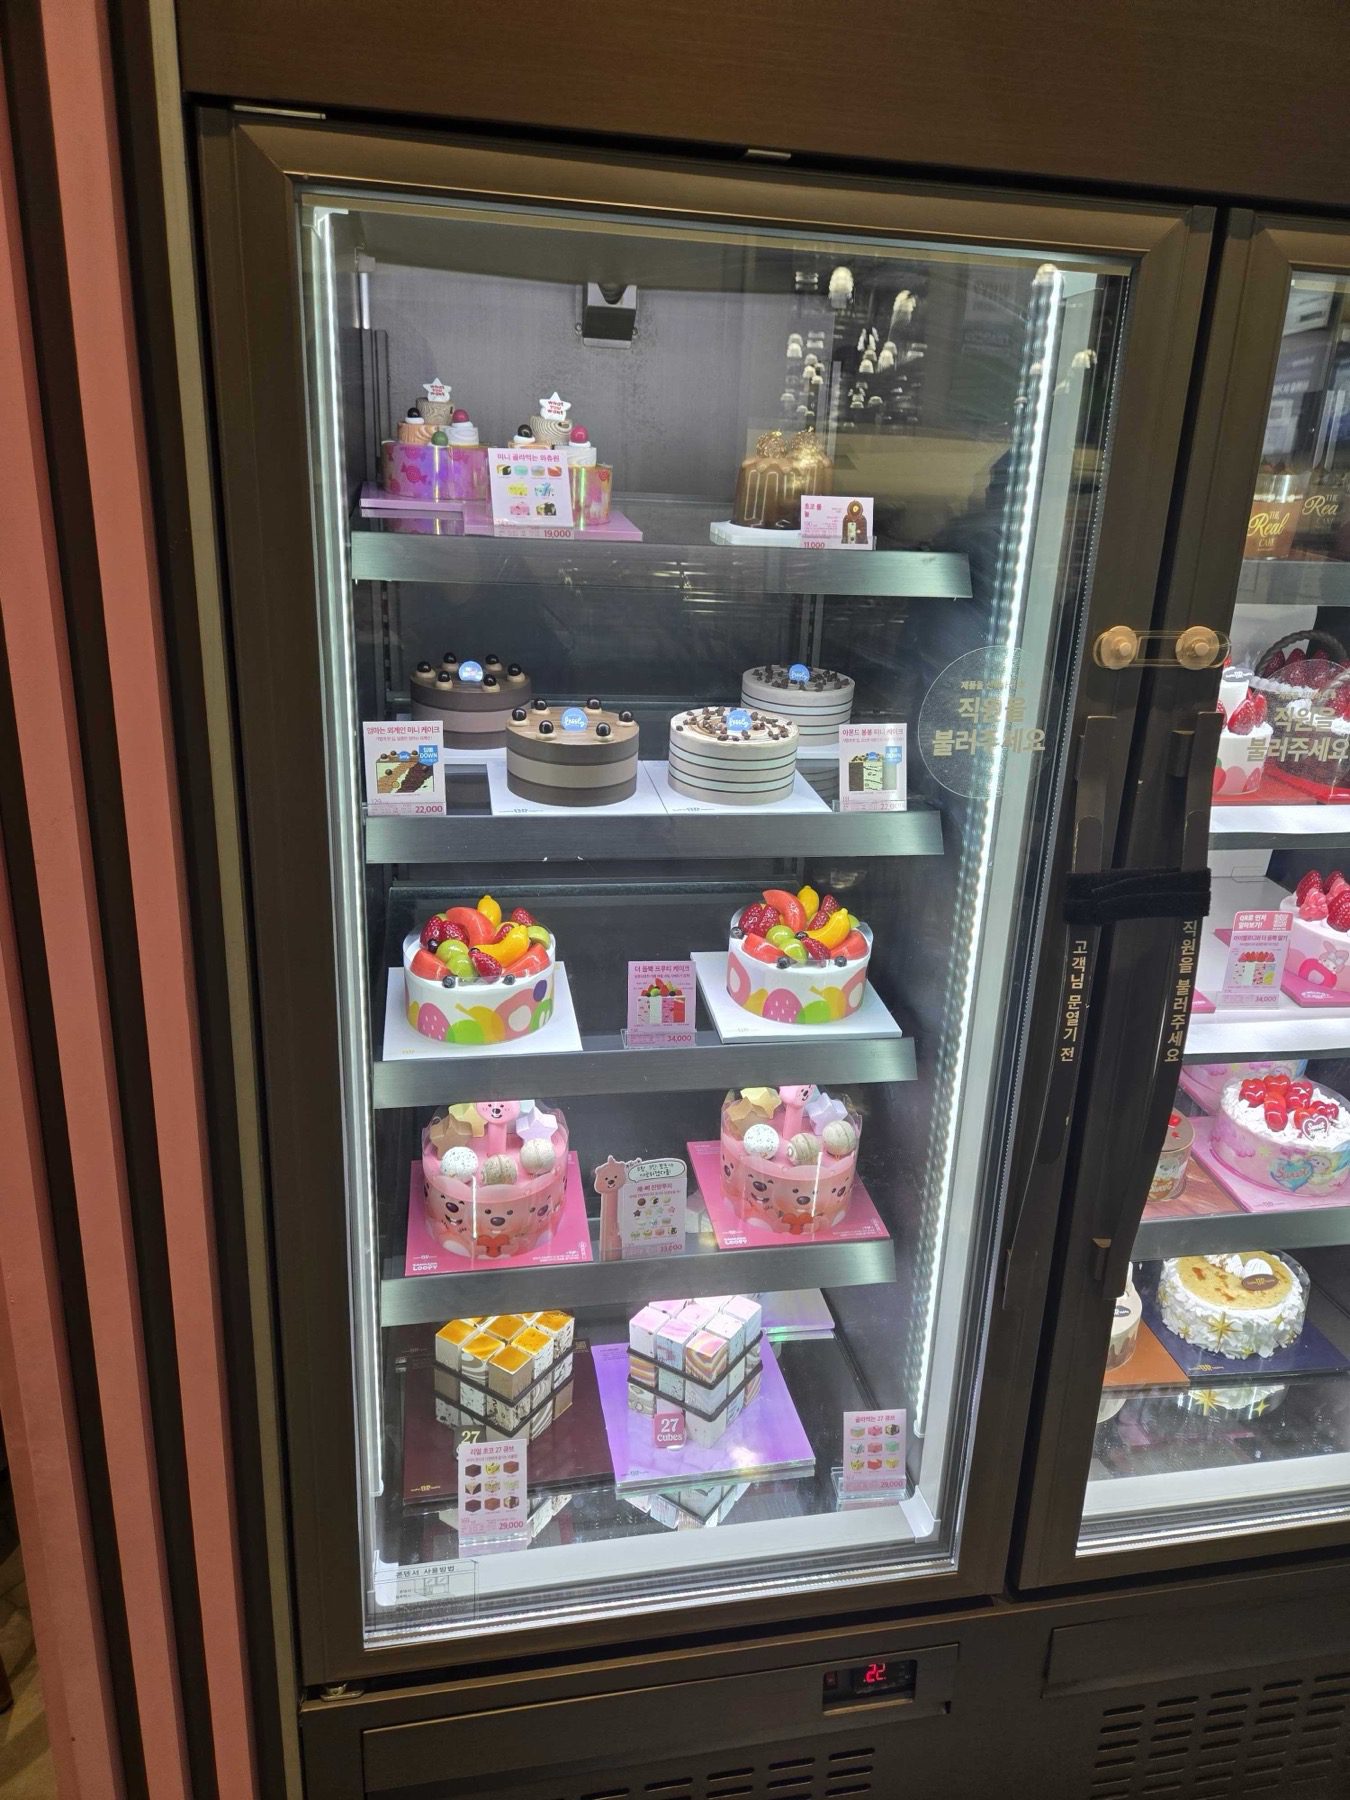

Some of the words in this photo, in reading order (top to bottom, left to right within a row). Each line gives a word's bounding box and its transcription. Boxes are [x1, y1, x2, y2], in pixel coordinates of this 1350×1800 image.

[544, 530, 571, 538] 19,000
[1247, 512, 1290, 538] Real
[958, 697, 1026, 724] 직원을
[1274, 706, 1336, 732] 직원을
[932, 728, 1046, 756] 불러주세요
[1247, 737, 1349, 762] 불러주세요
[416, 805, 443, 814] 22,000
[1180, 920, 1197, 974] 직원을
[1071, 940, 1087, 989] 고객님
[1064, 995, 1082, 1042] 문열기
[1164, 979, 1191, 1062] 불러주세요
[1061, 1047, 1074, 1062] 전
[462, 1430, 480, 1443] 27
[661, 1418, 679, 1432] 27
[500, 1521, 523, 1530] 29,000
[424, 1566, 454, 1574] 사용방법
